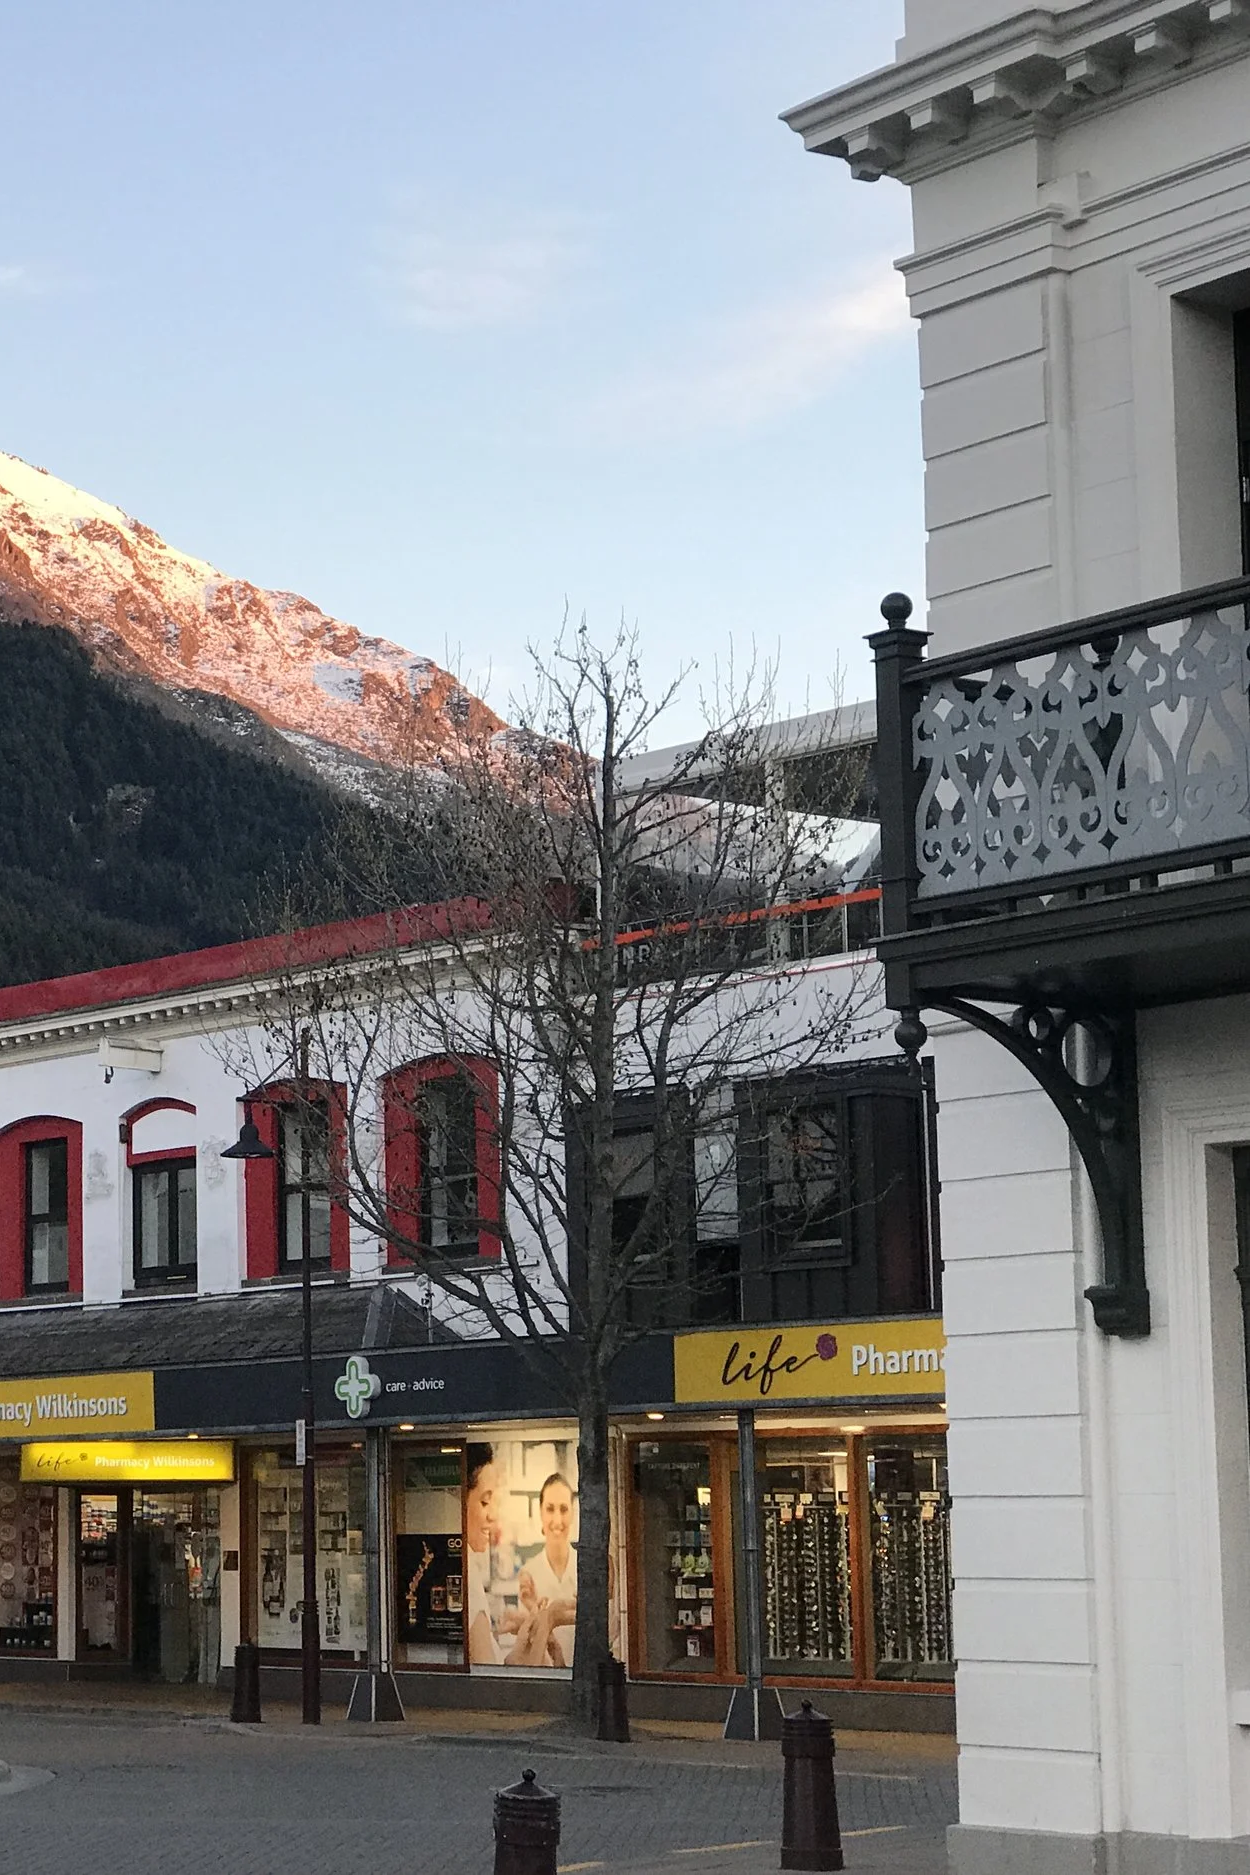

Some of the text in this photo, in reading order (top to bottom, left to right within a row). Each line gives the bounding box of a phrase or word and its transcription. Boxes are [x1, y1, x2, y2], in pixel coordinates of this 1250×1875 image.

[721, 1334, 820, 1395] life
[385, 1378, 445, 1392] care advice
[36, 1392, 128, 1419] Wilkinsons
[36, 1452, 215, 1471] life Pharmacy Wilkinsons
